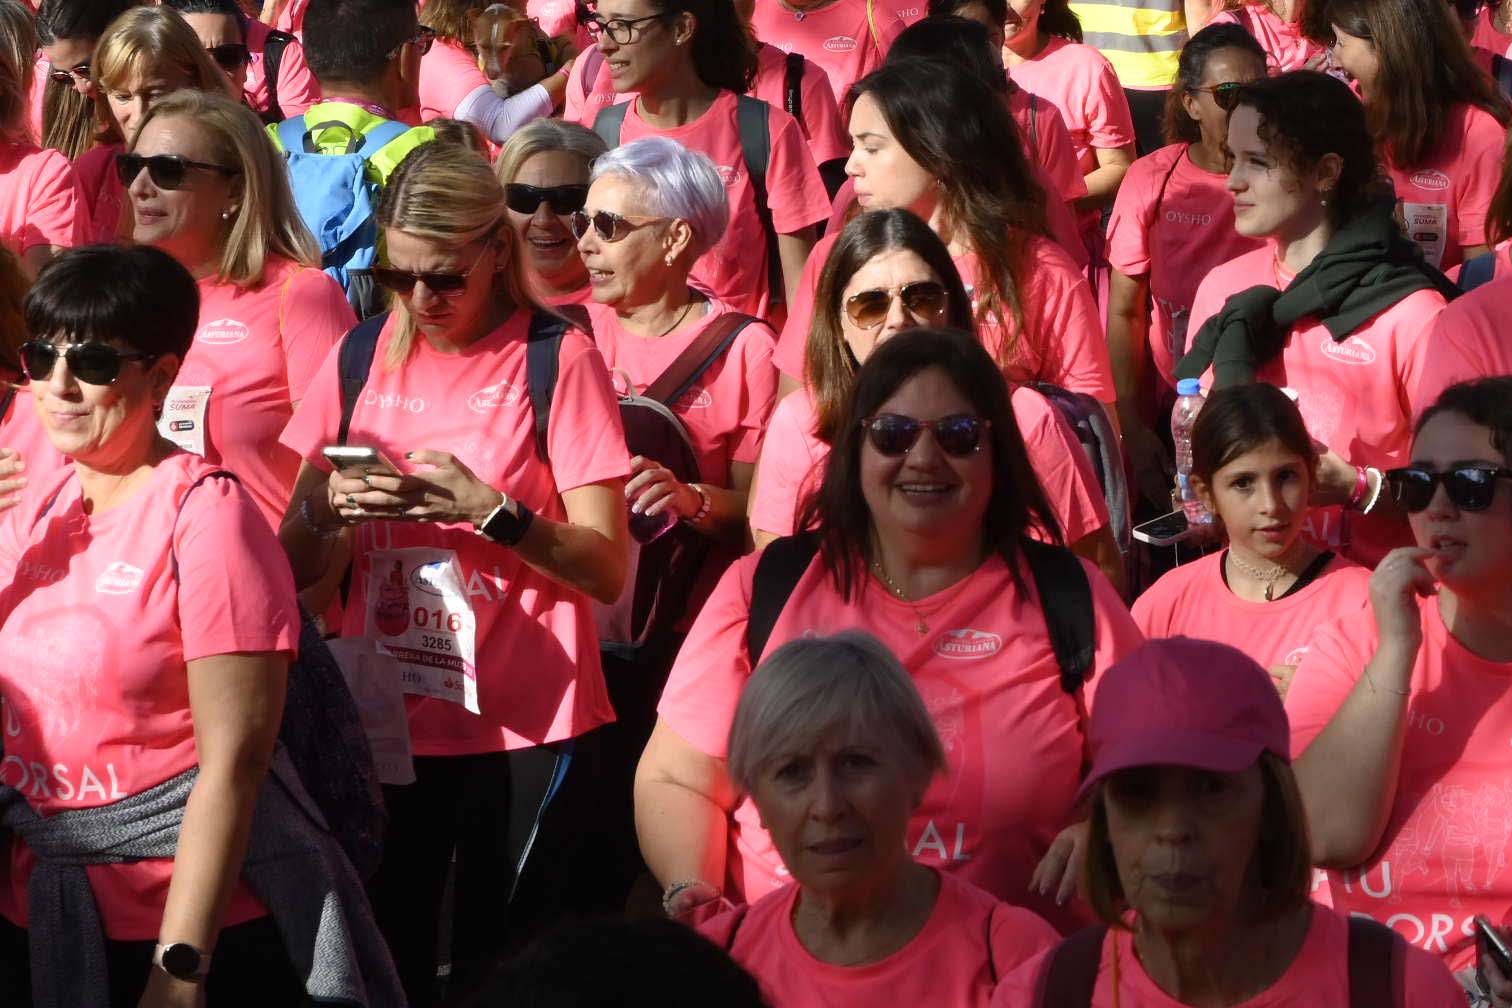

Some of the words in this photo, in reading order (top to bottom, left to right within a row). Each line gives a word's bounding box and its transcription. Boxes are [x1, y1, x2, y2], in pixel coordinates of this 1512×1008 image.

[1165, 210, 1212, 226] OYSHO
[1413, 216, 1438, 225] SUMA
[413, 606, 462, 632] 016
[421, 635, 452, 652] 3285
[938, 638, 997, 653] ASTURIANA
